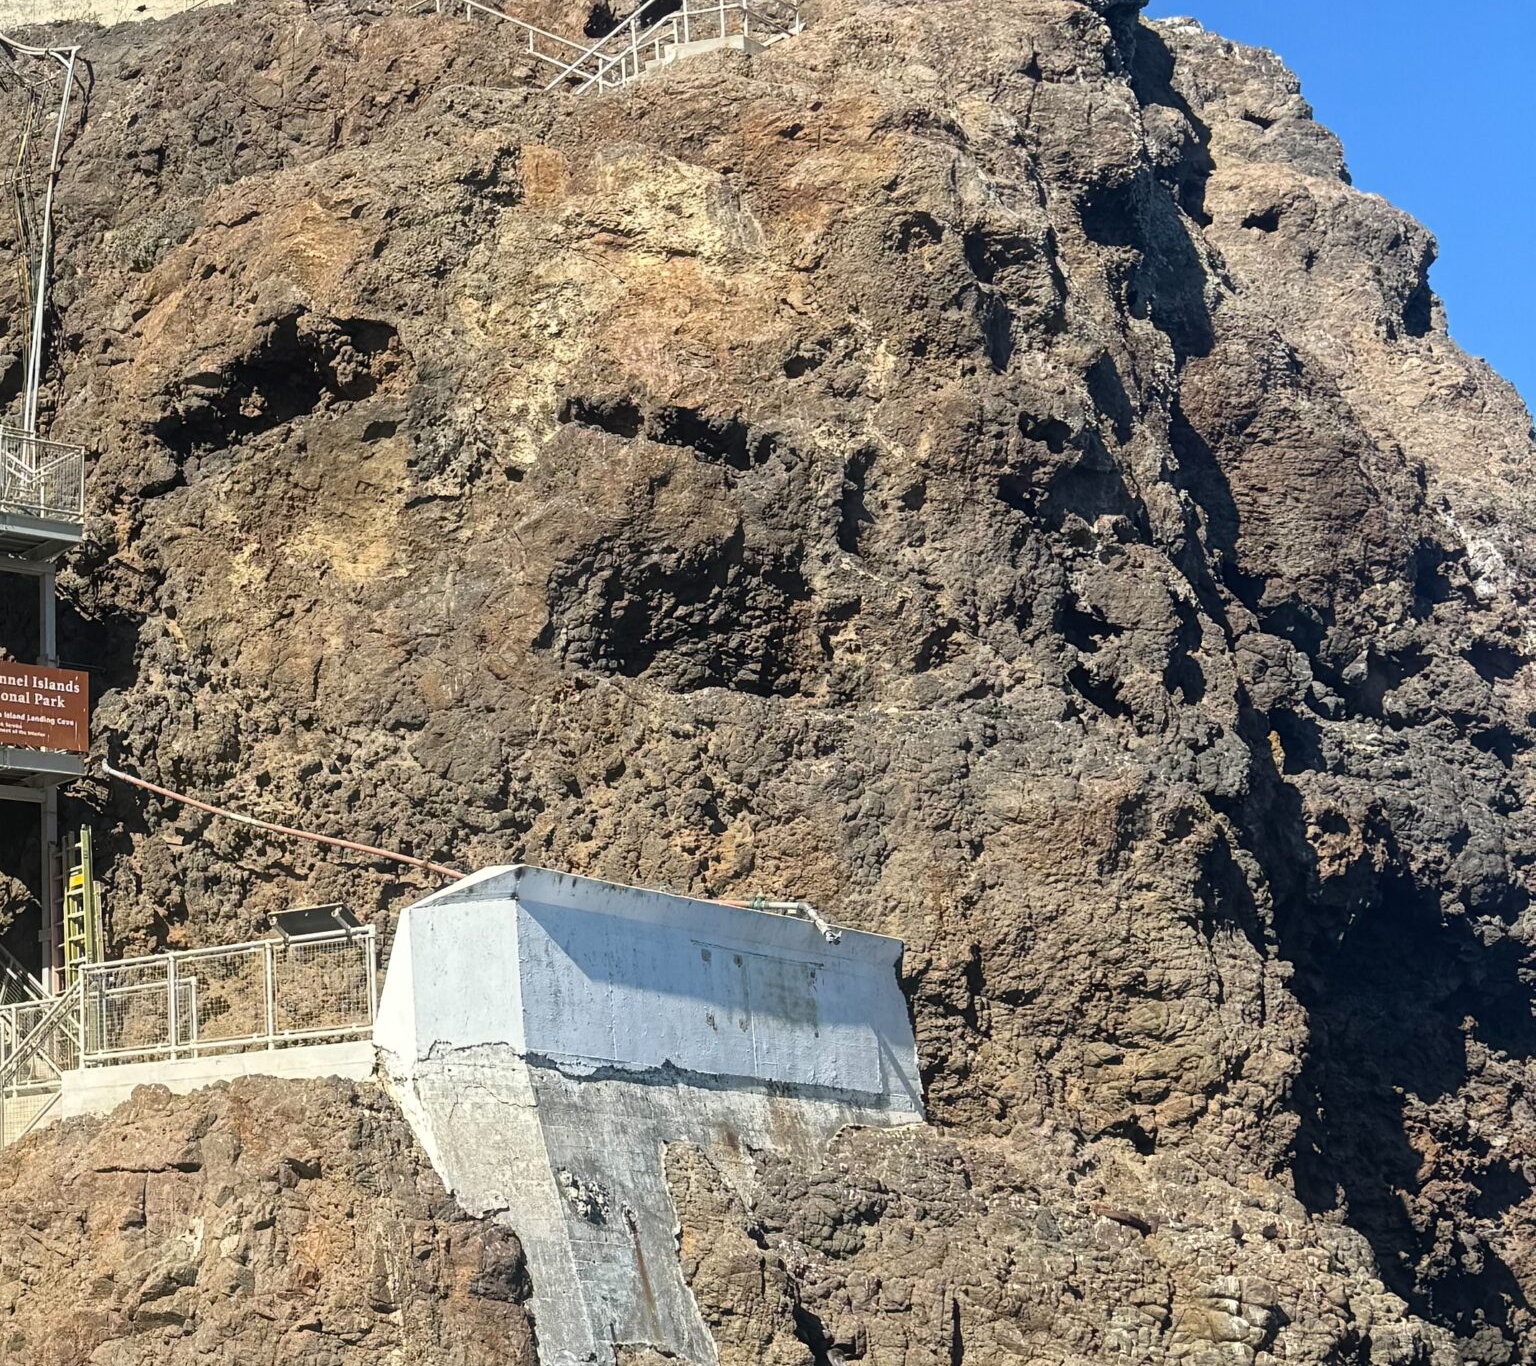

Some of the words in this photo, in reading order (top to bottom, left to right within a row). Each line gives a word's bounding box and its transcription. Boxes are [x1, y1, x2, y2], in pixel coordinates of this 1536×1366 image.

[32, 676, 80, 694] Islands
[34, 693, 65, 708] Park
[4, 711, 25, 721] Island
[27, 714, 55, 726] Landing
